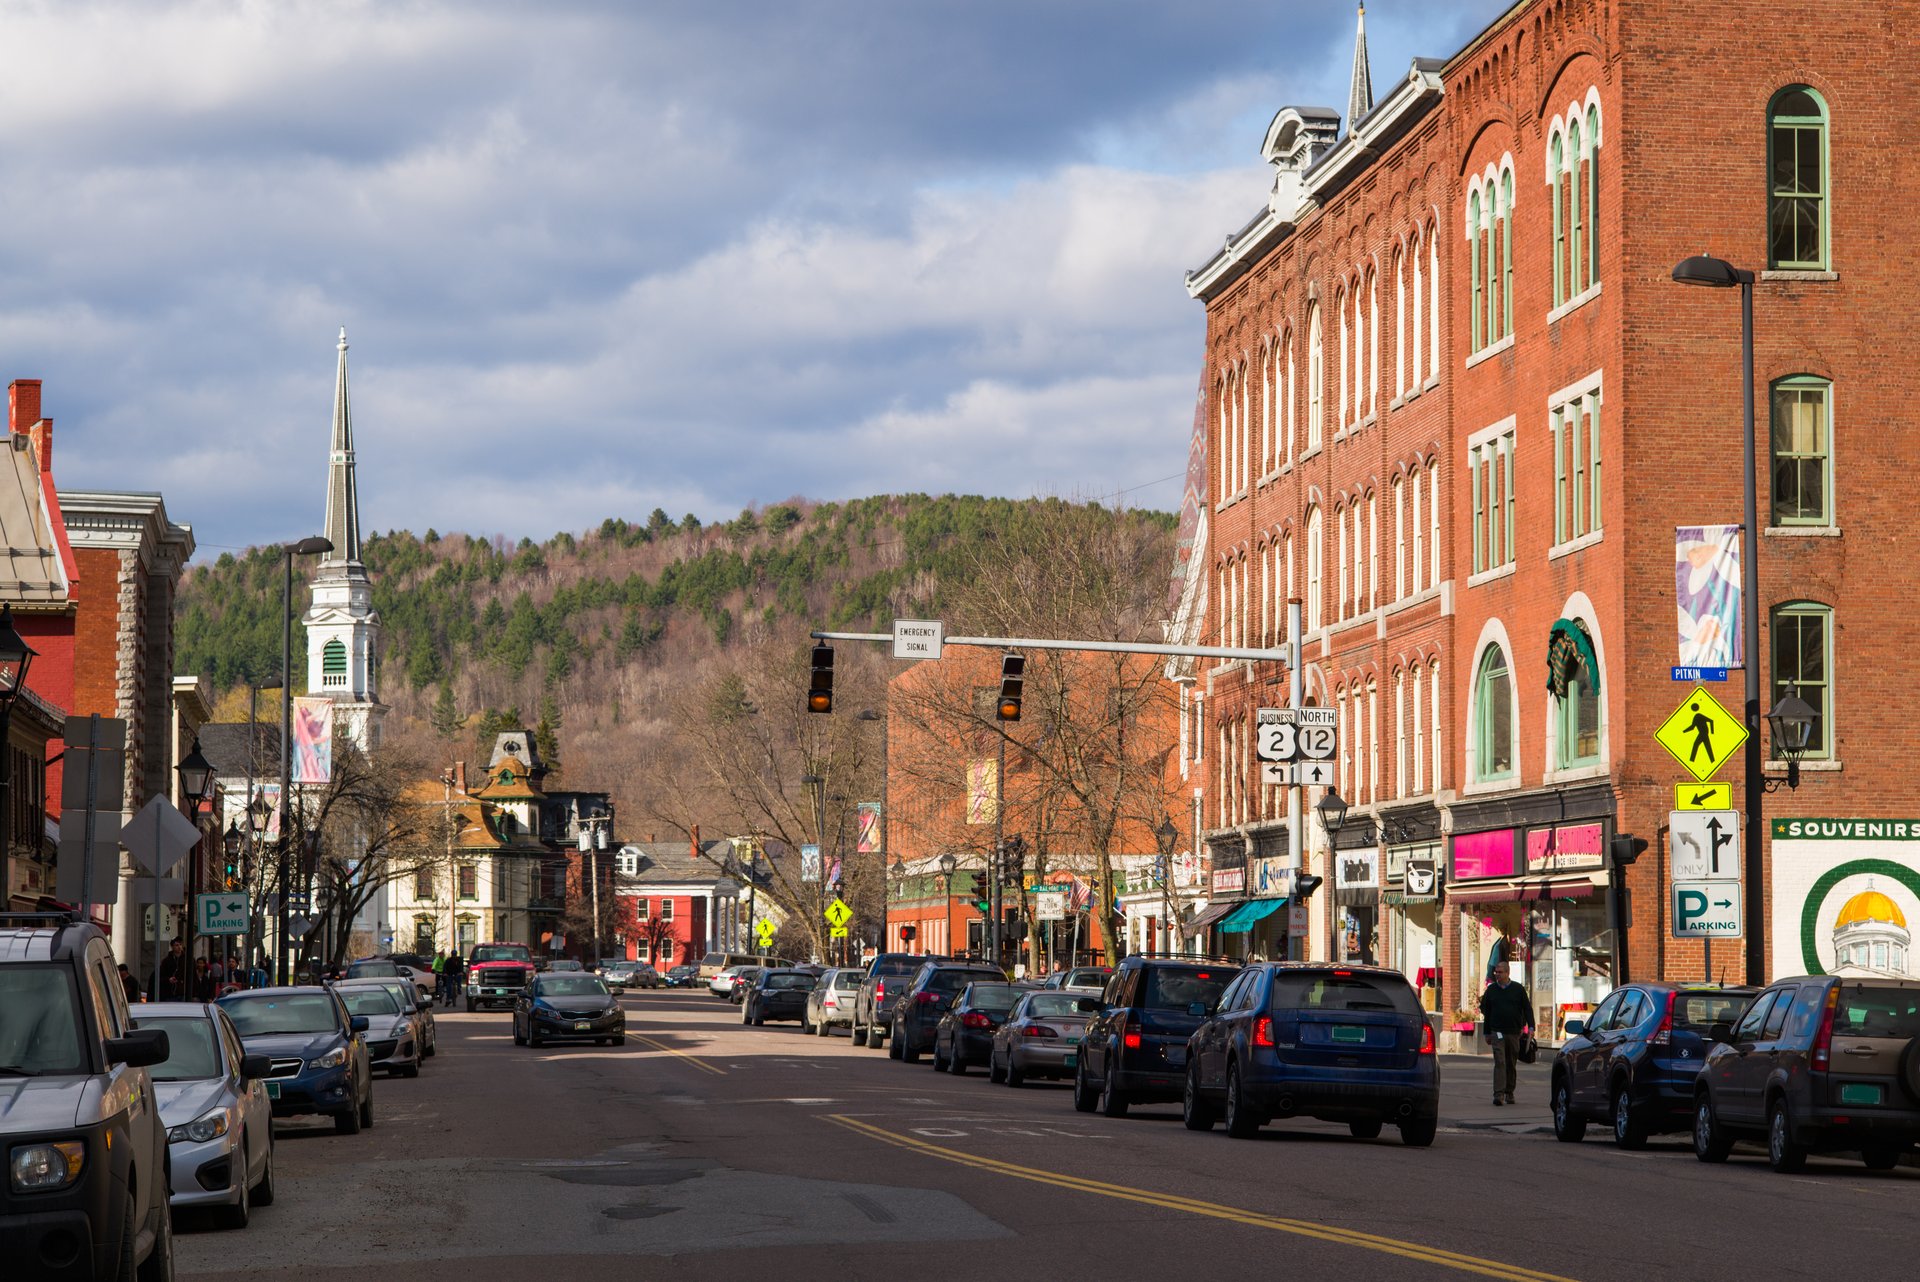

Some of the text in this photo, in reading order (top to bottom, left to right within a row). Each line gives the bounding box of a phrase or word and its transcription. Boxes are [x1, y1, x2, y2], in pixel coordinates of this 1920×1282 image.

[900, 628, 936, 637] EMERGENCY
[907, 643, 928, 652] SIGNAL
[1675, 669, 1701, 679] PITKIN
[1261, 713, 1293, 723] BUSINESS
[1300, 710, 1335, 722] NORTH
[1270, 731, 1284, 752] 2
[1305, 730, 1329, 750] 12
[1789, 822, 1920, 837] SOUVENIRS
[1676, 864, 1703, 875] ONLY
[206, 900, 243, 928] PARKING
[1678, 891, 1736, 930] PARKING
